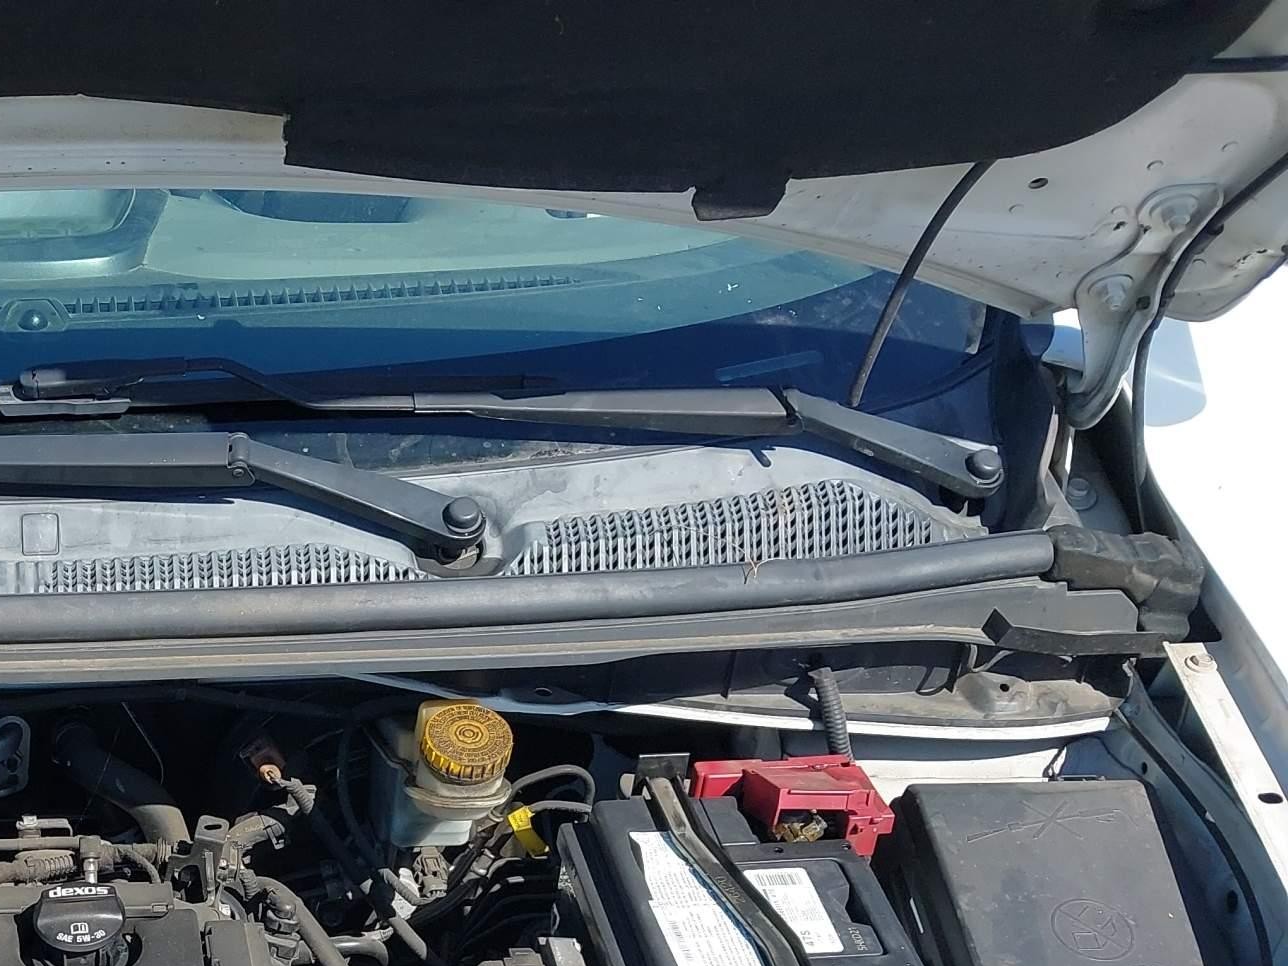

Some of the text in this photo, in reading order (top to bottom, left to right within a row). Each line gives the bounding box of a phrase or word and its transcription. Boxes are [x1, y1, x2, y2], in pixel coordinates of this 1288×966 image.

[49, 886, 110, 898] dexos
[56, 930, 106, 943] SAE 5W-30
